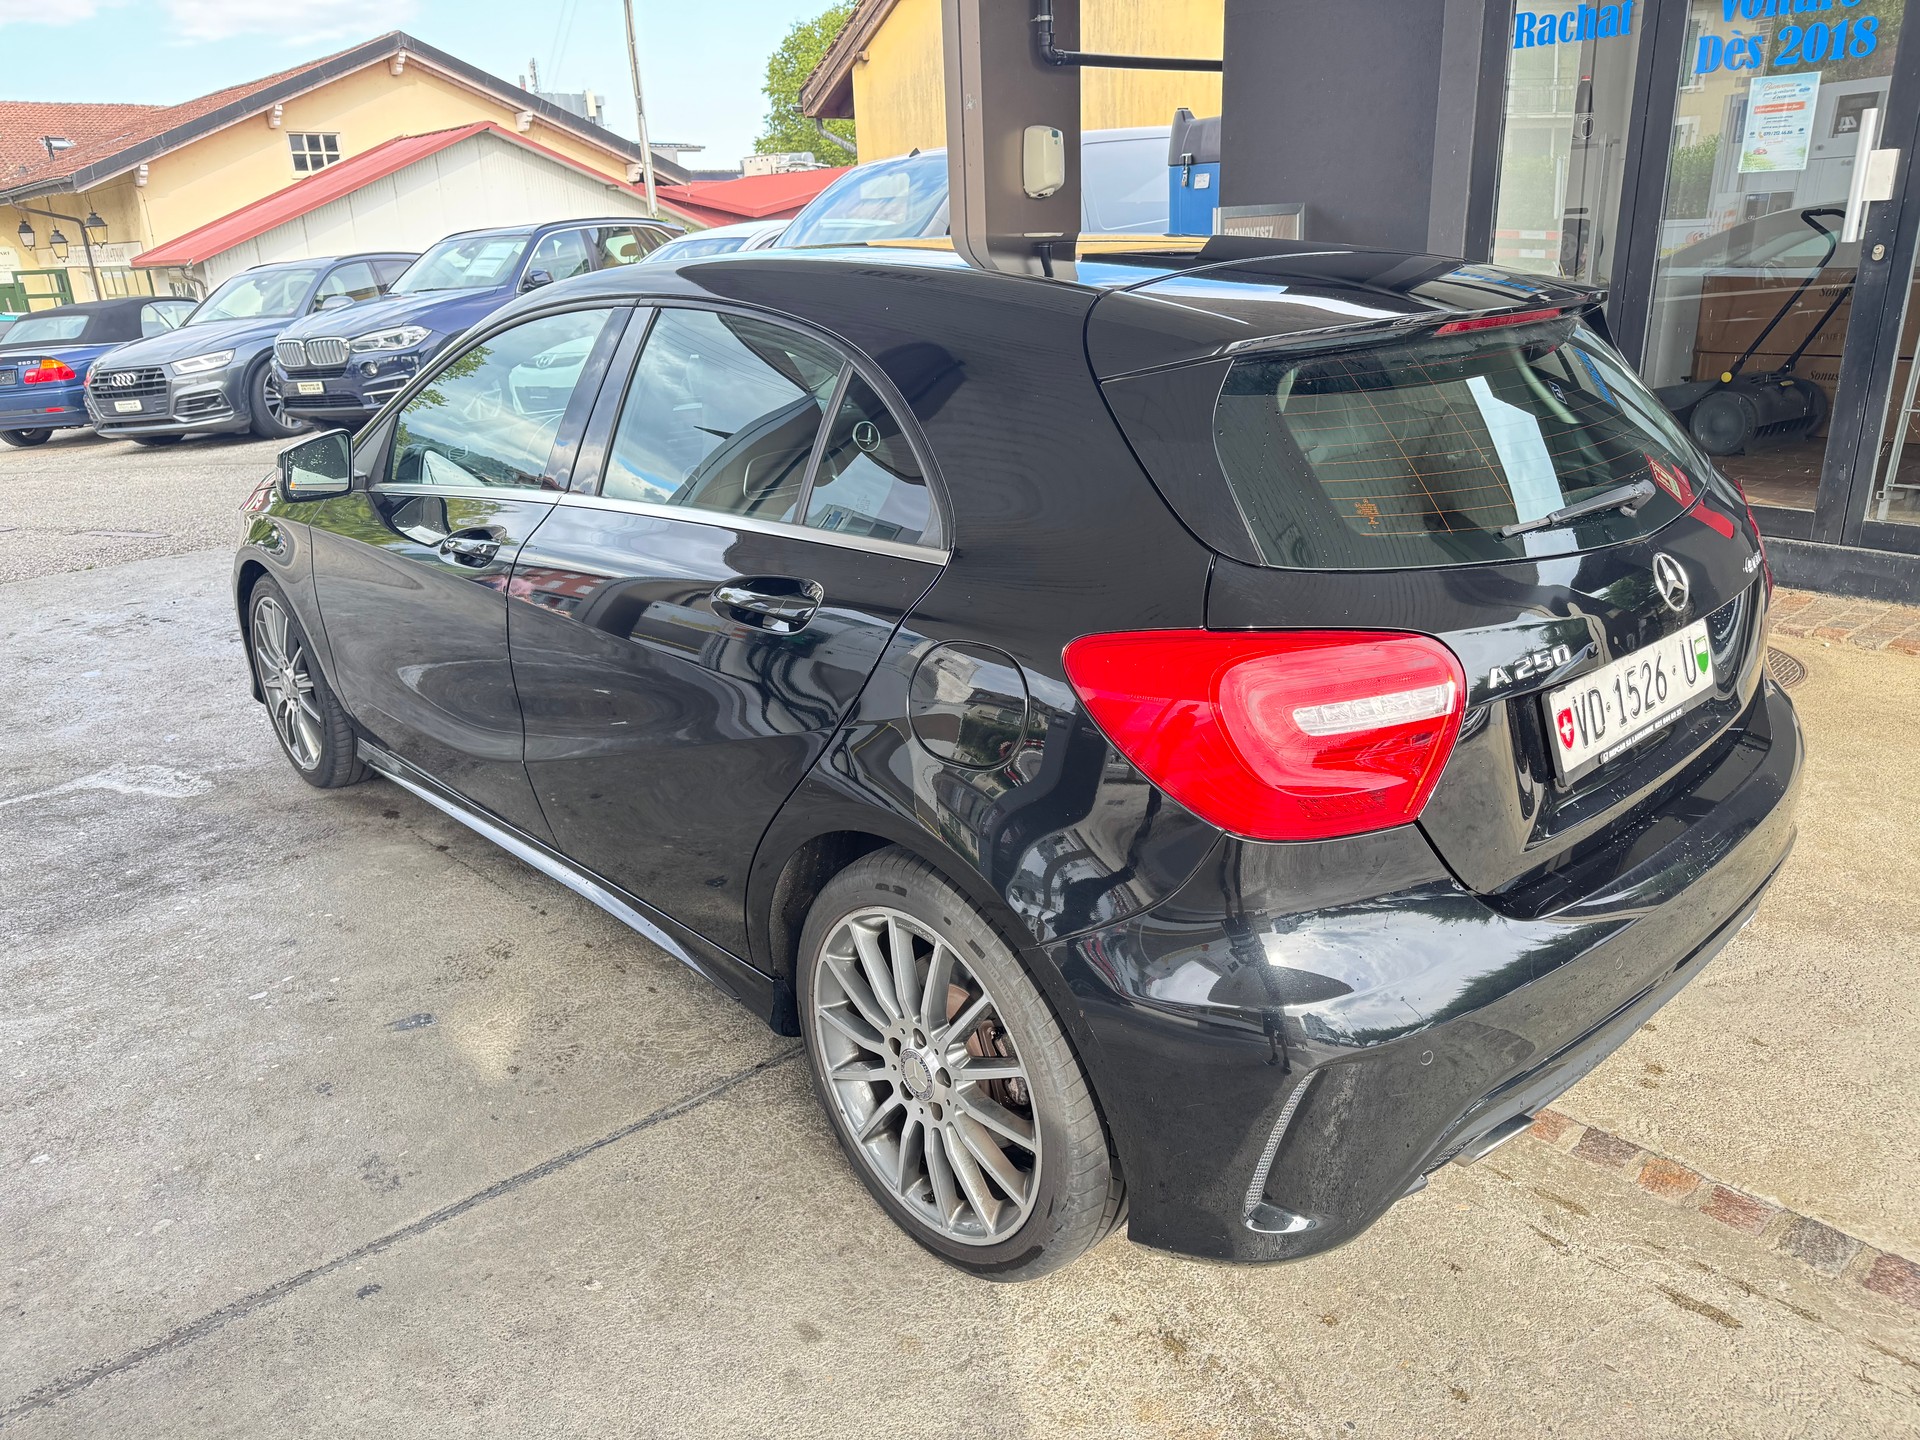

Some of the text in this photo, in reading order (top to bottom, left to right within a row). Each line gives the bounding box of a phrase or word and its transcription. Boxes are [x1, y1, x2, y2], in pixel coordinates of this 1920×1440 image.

[1513, 0, 1635, 49] Rachat
[1694, 16, 1879, 74] Dès 2018
[1488, 643, 1572, 689] A 250
[1572, 637, 1698, 749] VD 1526 U
